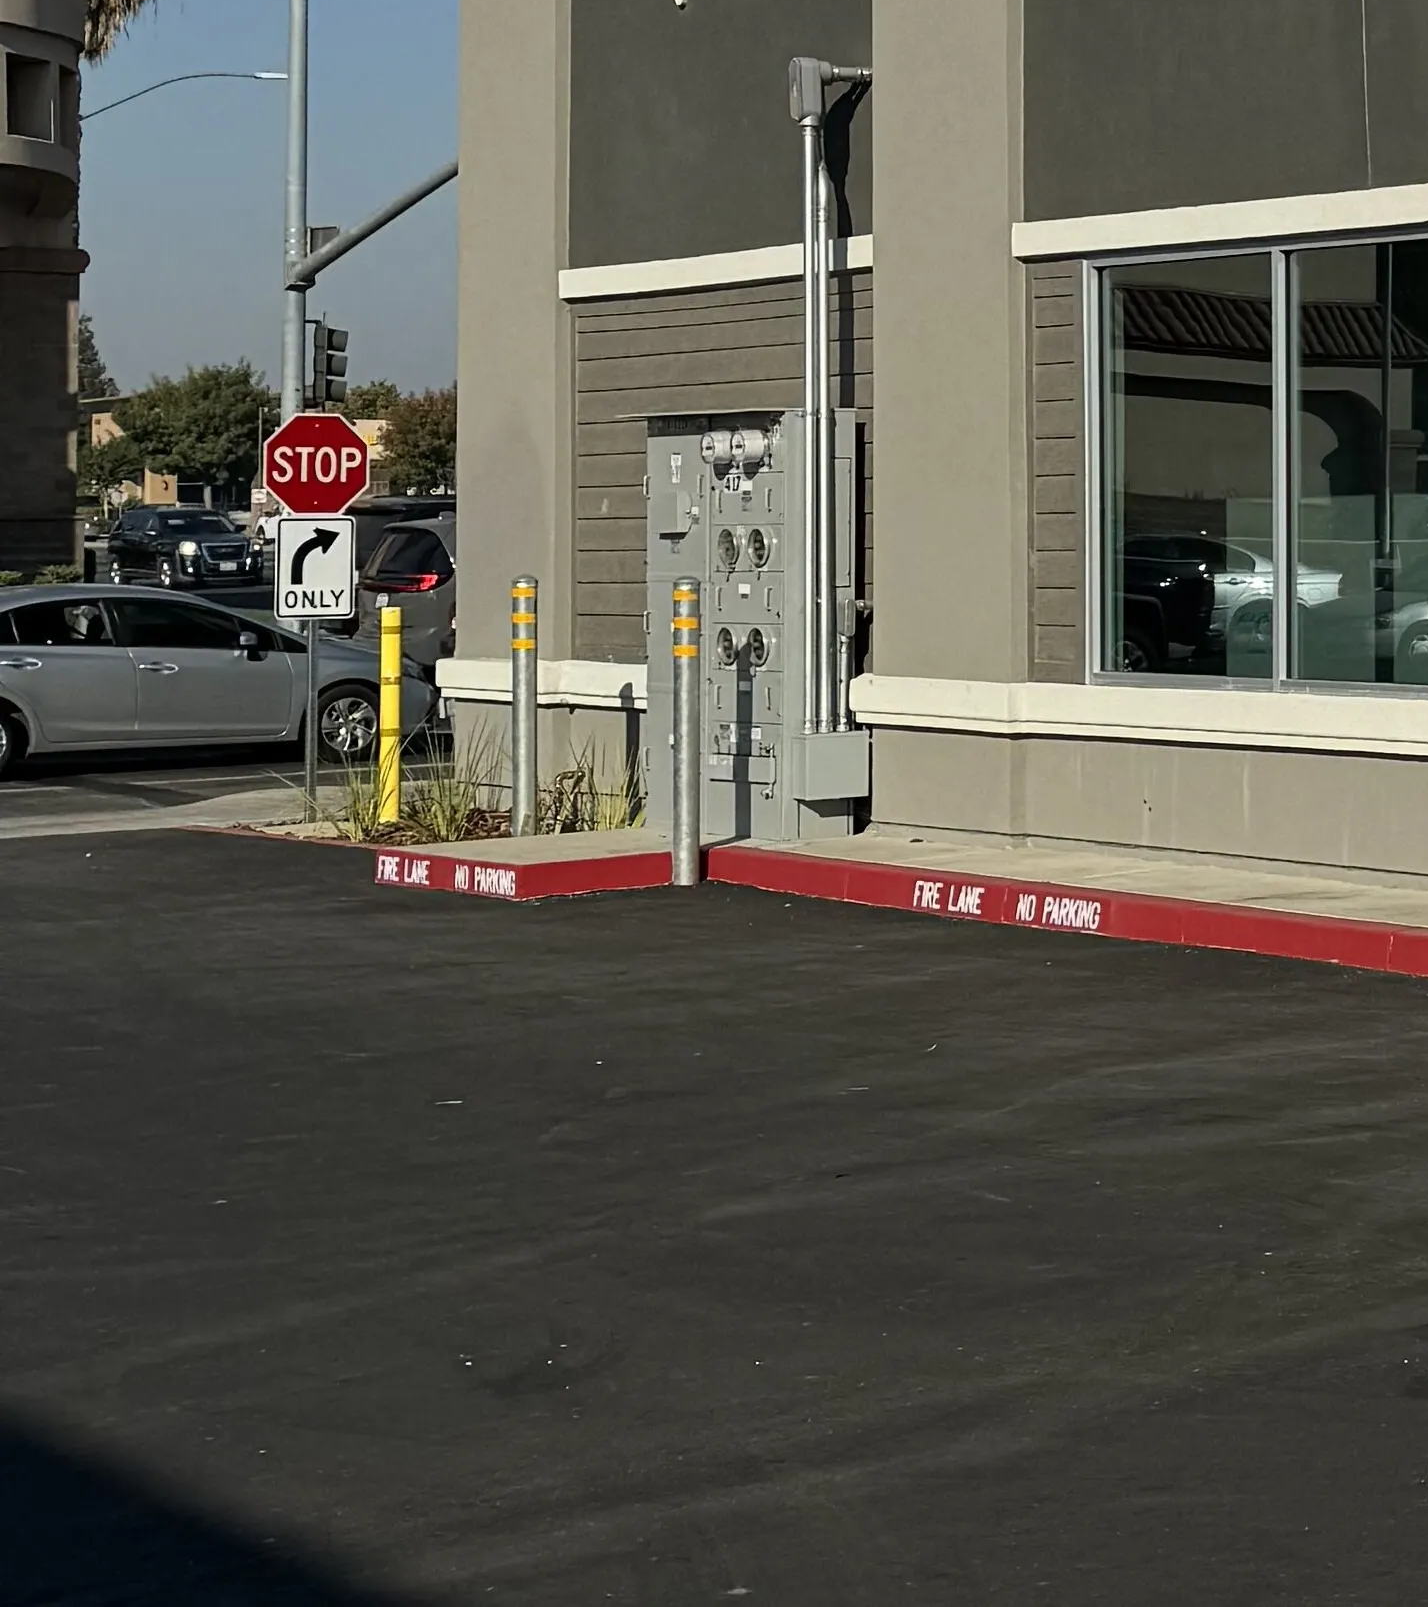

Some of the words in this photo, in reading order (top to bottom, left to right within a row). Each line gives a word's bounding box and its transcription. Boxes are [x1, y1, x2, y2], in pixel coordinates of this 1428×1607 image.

[272, 446, 362, 483] STOP
[284, 589, 344, 609] ONLY
[377, 855, 400, 881] FIRE
[404, 858, 431, 885] LANE
[454, 864, 469, 890] NO
[474, 866, 516, 896] PARKING
[913, 880, 944, 909] FIRE
[948, 884, 984, 915] LANE
[1016, 893, 1036, 921] NO
[1042, 896, 1100, 929] PARKING
